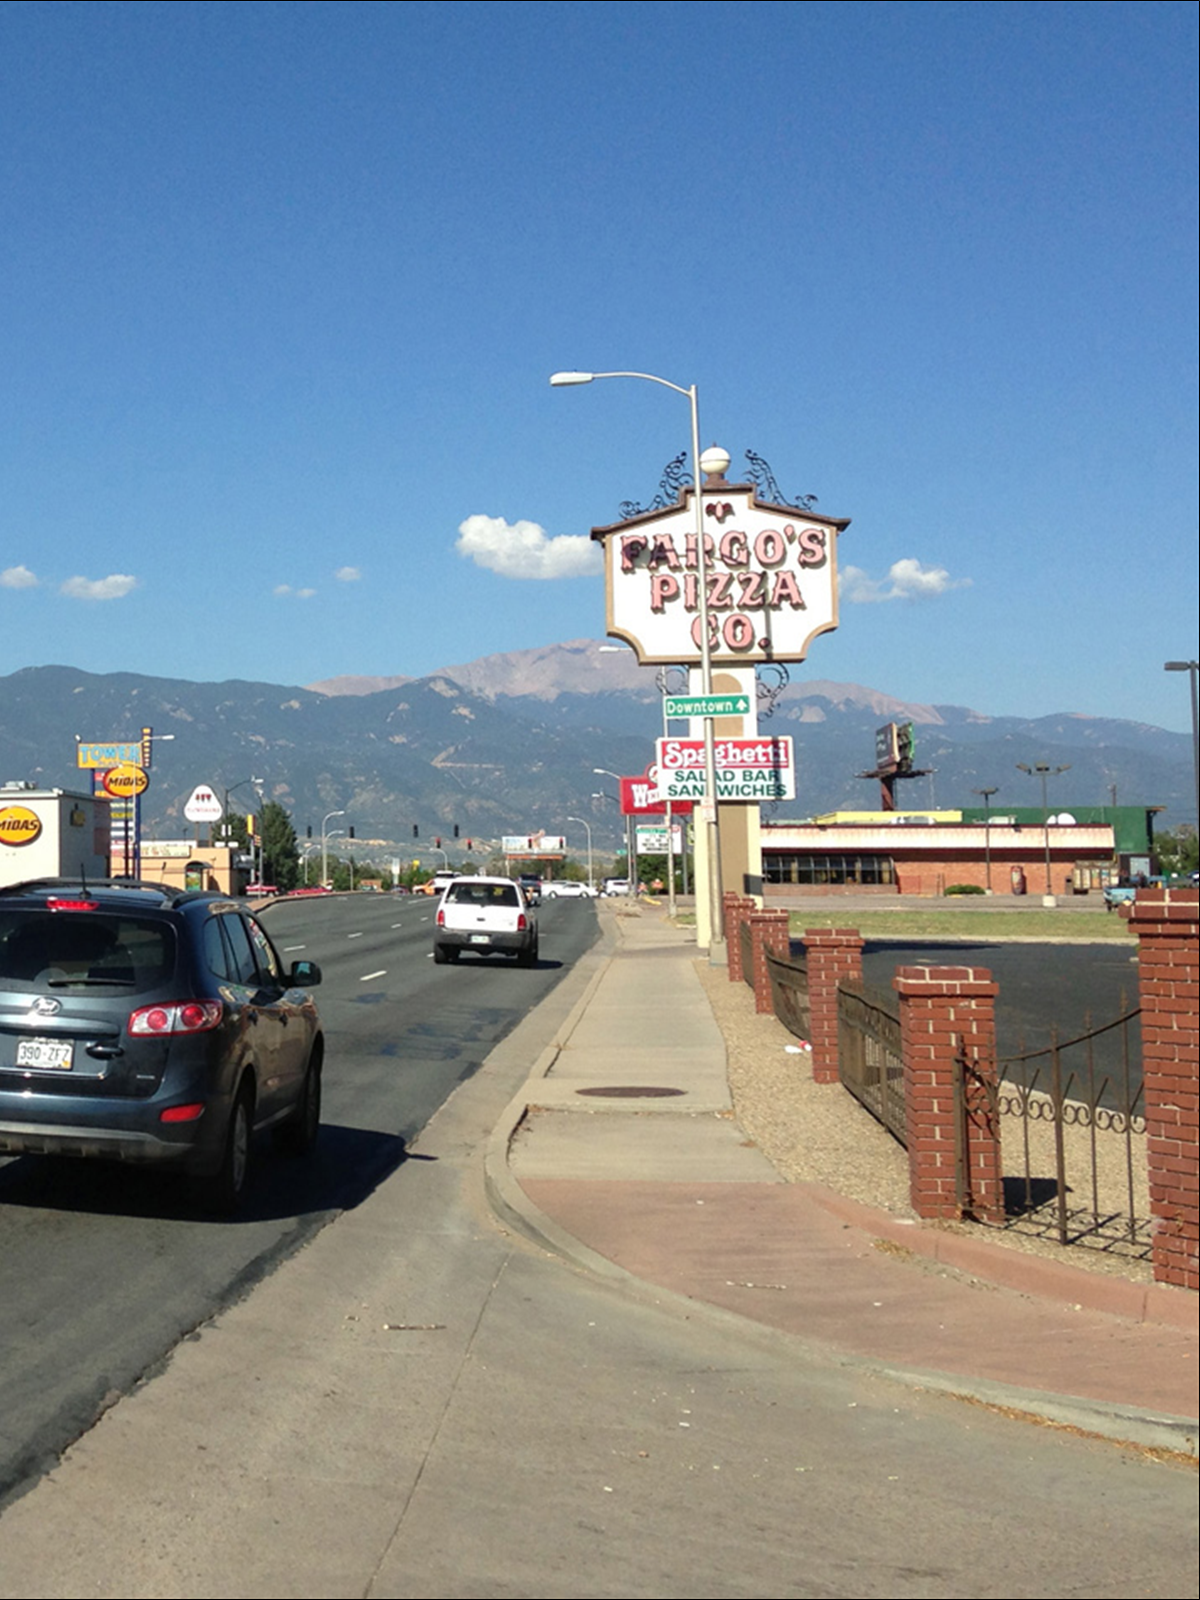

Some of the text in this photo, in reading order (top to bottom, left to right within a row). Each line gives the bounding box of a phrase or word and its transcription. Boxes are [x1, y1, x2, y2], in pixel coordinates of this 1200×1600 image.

[619, 523, 827, 572] FARGO'S
[650, 570, 804, 610] PIZZA
[690, 613, 772, 650] CO.
[667, 700, 733, 715] Downtown
[81, 745, 140, 763] TOWER
[664, 741, 787, 768] Spaghetti
[108, 775, 146, 787] MIDAS
[675, 770, 780, 782] SALAD BAR
[668, 784, 787, 797] SANWICHES
